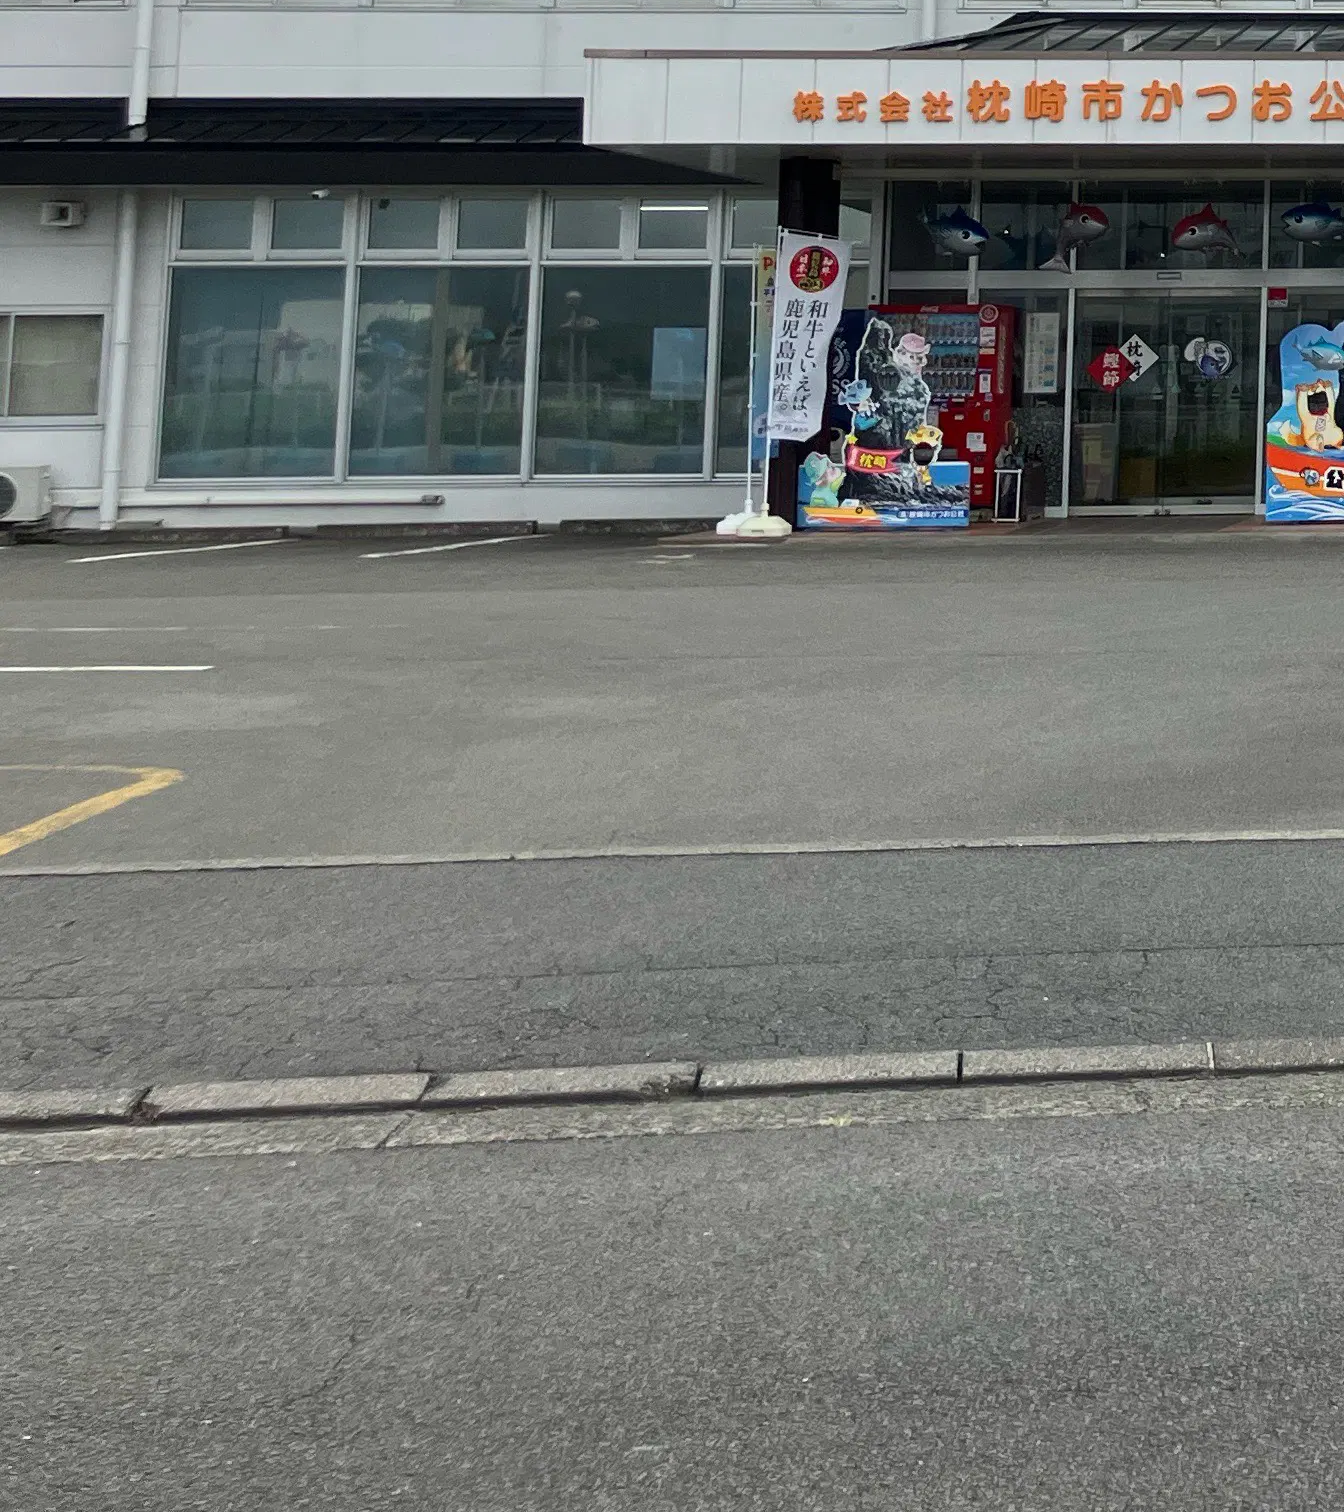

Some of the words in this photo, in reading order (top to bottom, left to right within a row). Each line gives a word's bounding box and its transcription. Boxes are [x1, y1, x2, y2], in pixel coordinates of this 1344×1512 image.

[773, 298, 805, 411] 鹿児島県産。
[791, 299, 829, 418] 和牛といえば、
